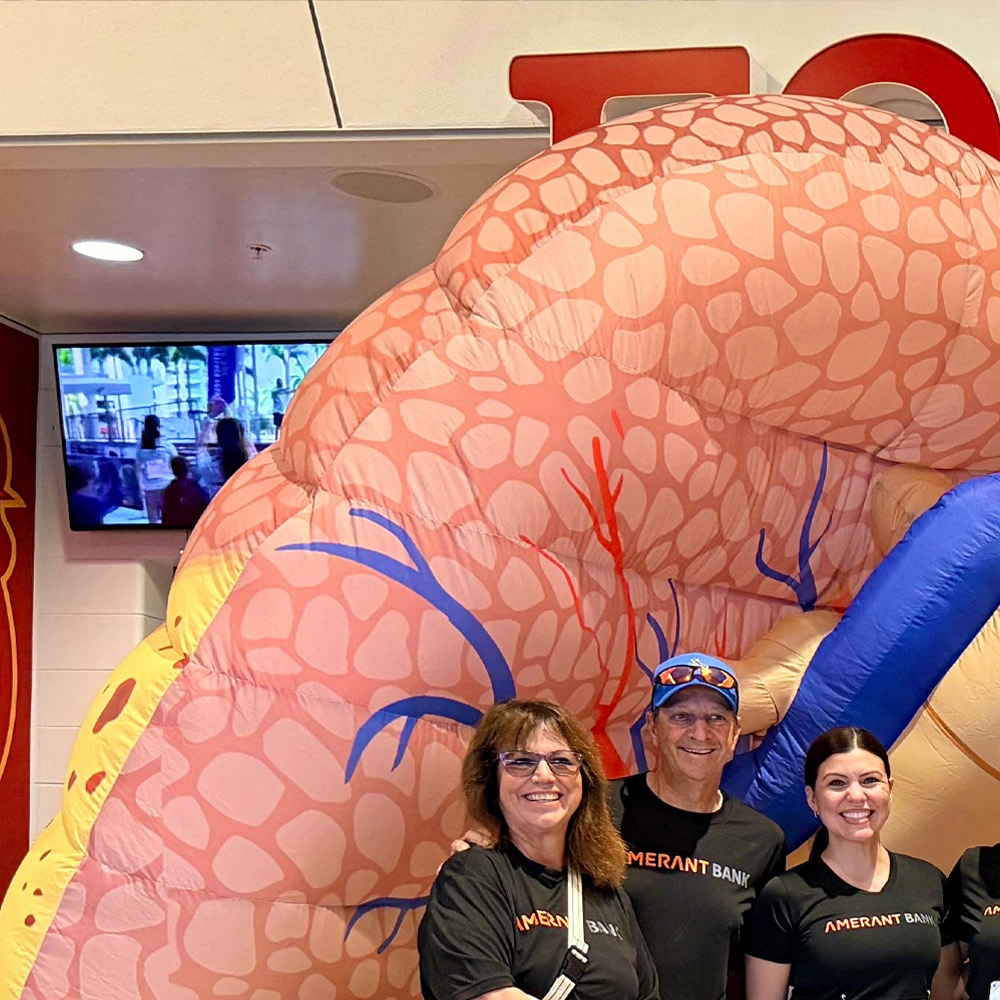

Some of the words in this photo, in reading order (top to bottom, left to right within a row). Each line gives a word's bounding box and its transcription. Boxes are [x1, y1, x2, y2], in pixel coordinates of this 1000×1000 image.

[626, 851, 709, 875] MERANT
[712, 862, 750, 888] BANK
[825, 913, 901, 933] AMERANT
